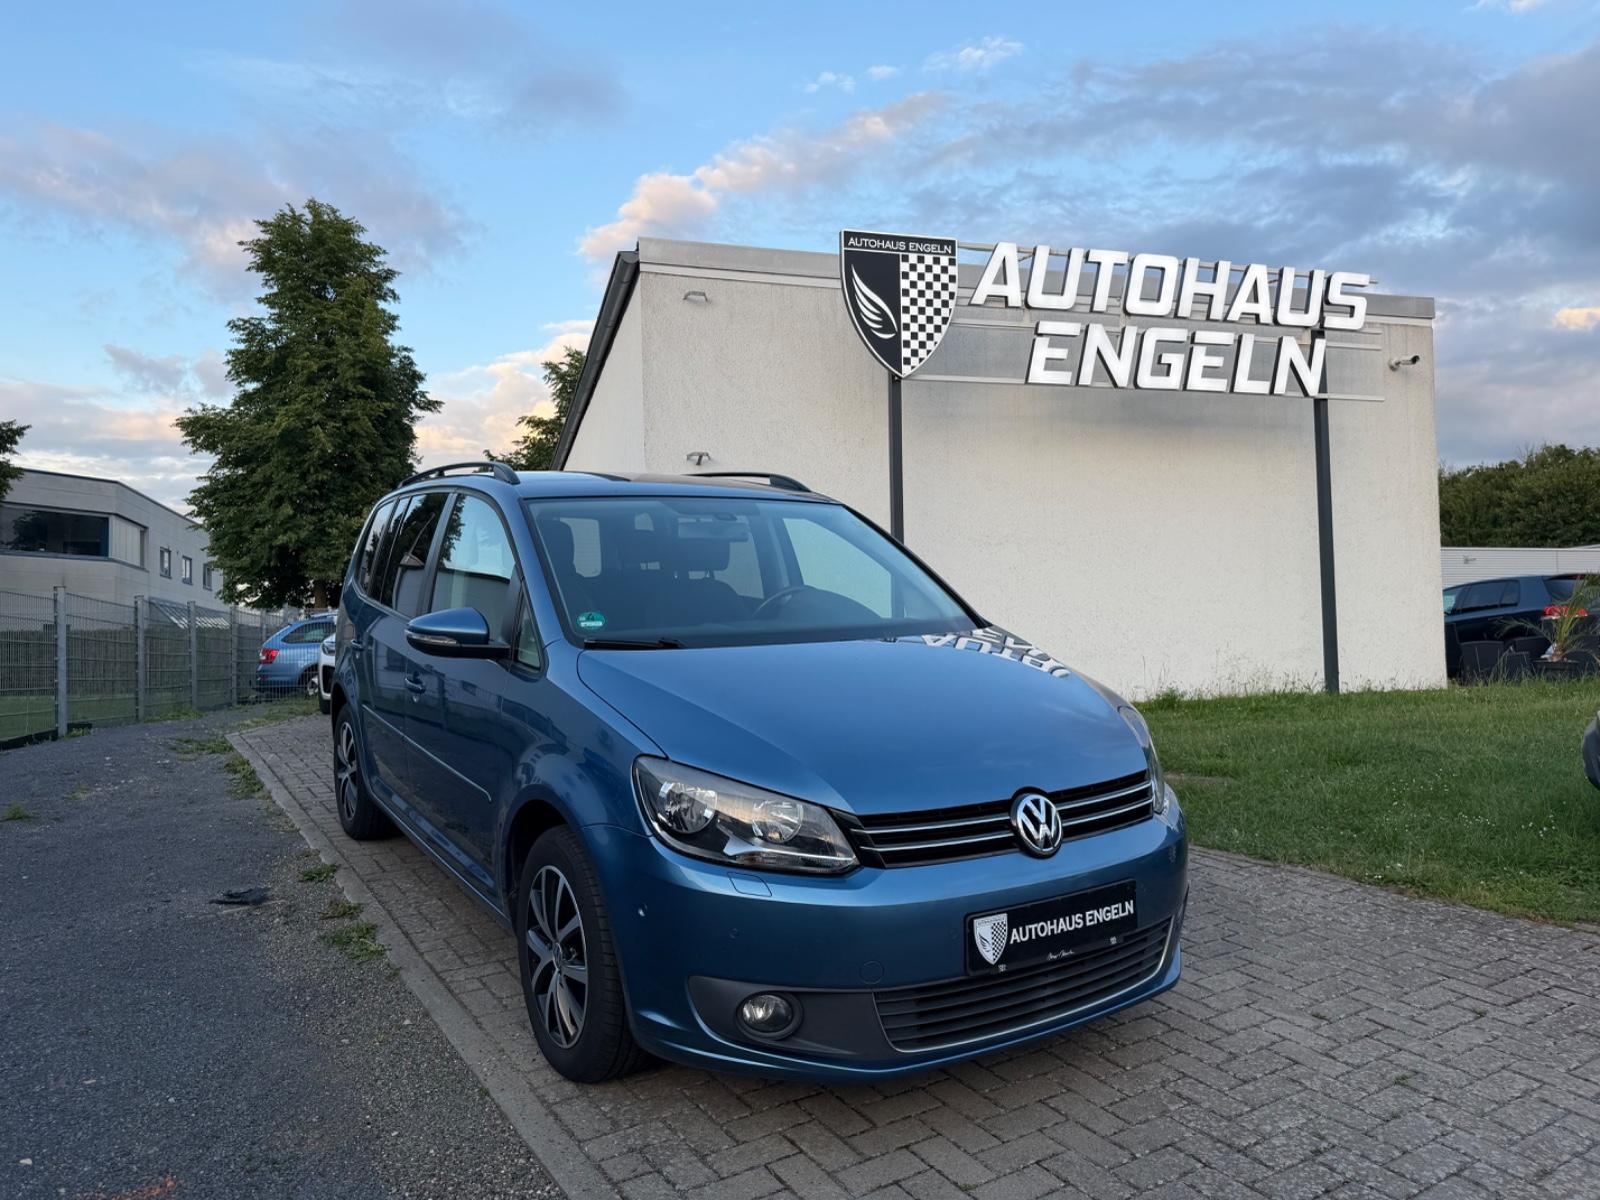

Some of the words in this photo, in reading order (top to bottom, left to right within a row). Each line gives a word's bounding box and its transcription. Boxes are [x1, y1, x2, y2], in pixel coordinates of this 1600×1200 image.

[848, 237, 906, 250] AUTOHAUS
[909, 242, 952, 254] ENGELN
[969, 241, 1371, 331] AUTOHAUS
[1026, 320, 1326, 397] ENGELN
[1009, 913, 1084, 944] AUTOHAUS
[1085, 900, 1134, 926] ENGELN
